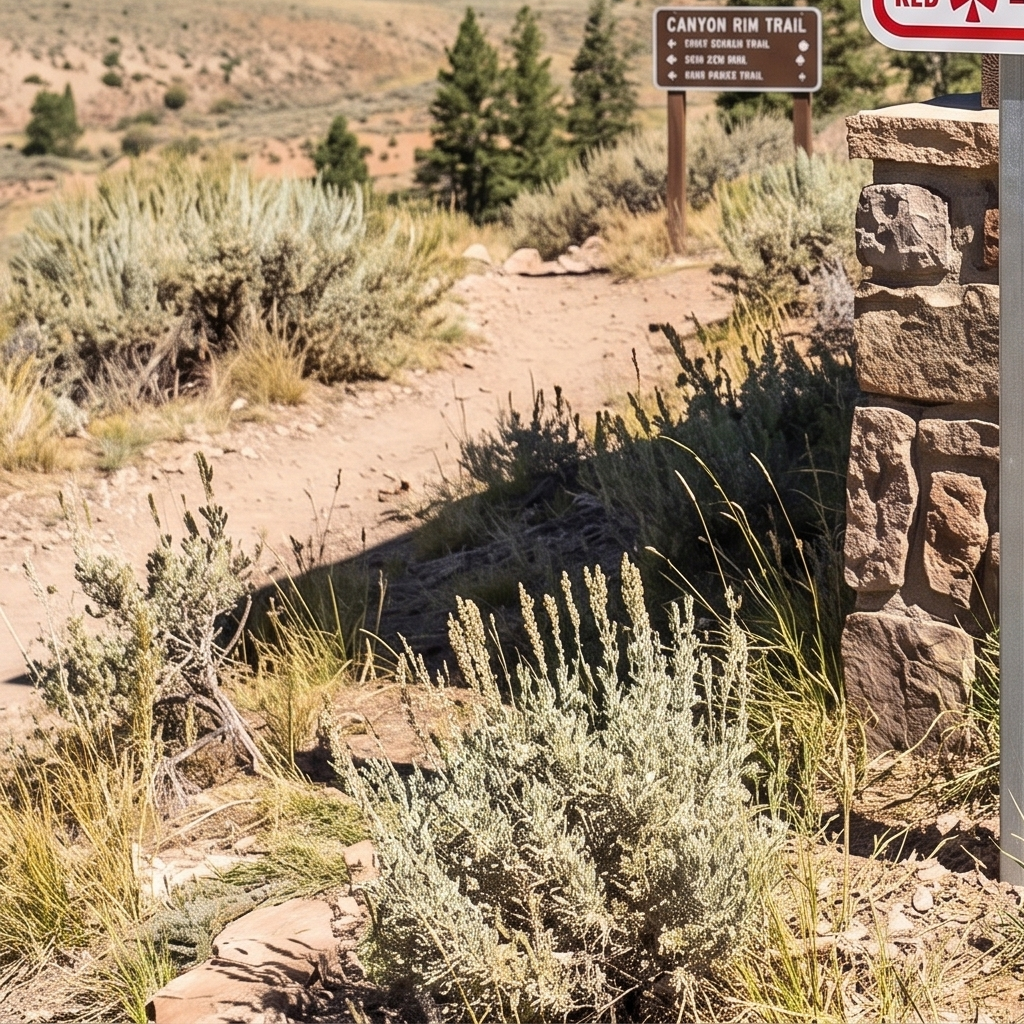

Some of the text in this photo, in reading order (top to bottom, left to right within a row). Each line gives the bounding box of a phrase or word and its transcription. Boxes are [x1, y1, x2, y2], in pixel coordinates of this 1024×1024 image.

[666, 16, 807, 34] CANYON RIM TRAIL
[746, 39, 770, 50] TRAIL
